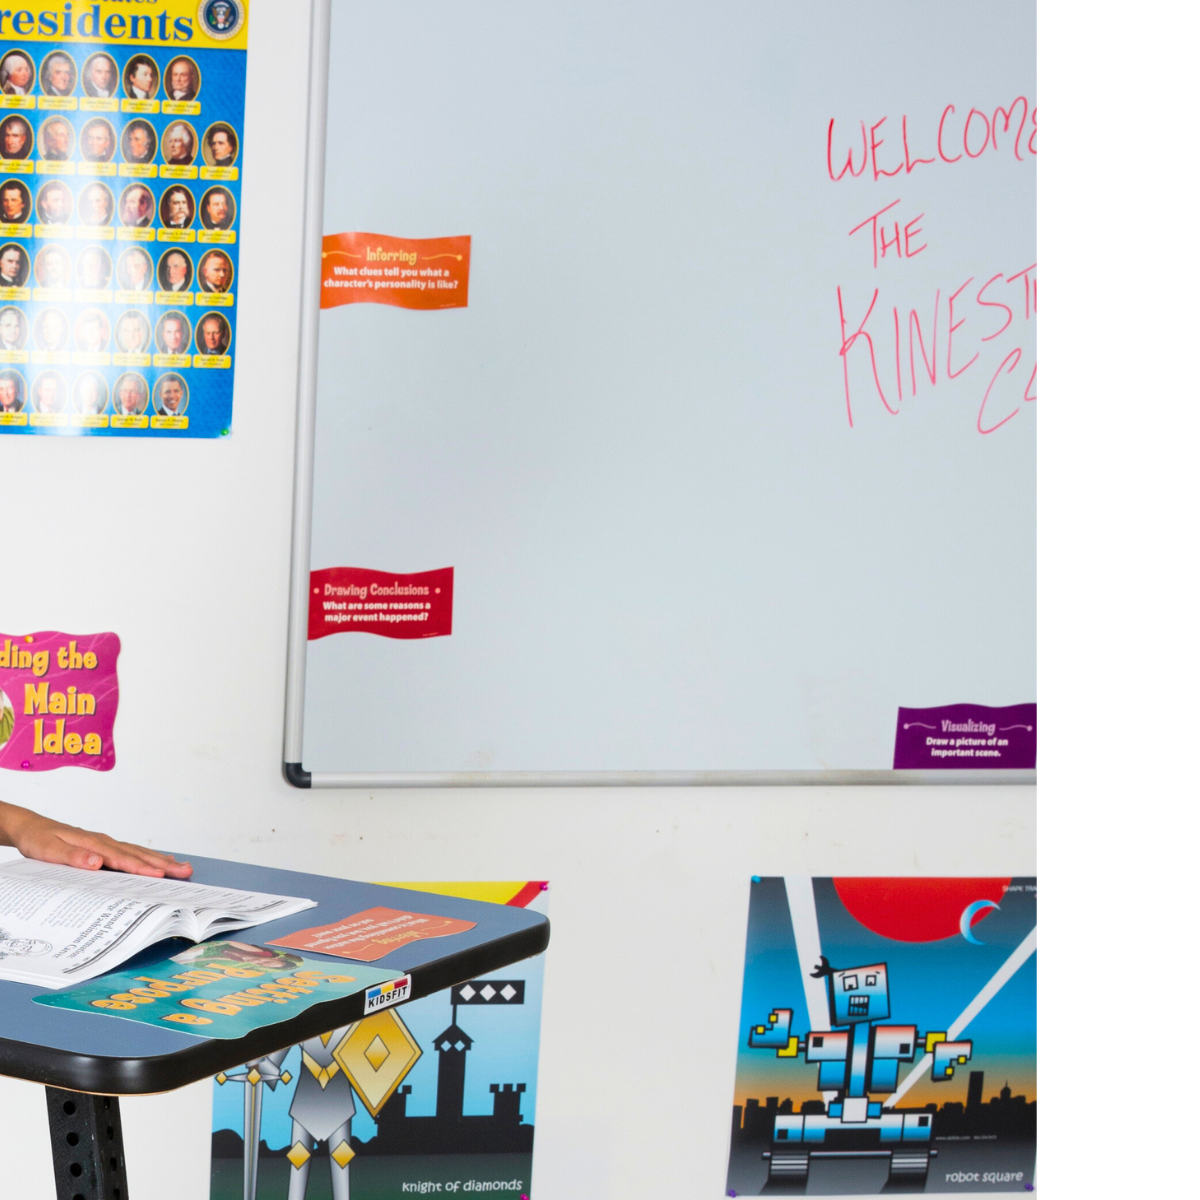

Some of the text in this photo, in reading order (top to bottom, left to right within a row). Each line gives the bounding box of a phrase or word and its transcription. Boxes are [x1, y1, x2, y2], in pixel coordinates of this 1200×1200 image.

[849, 199, 927, 268] THE
[367, 247, 417, 266] Inferring
[334, 267, 442, 278] What clues tell you what
[375, 280, 426, 290] personality
[437, 281, 458, 289] like?
[838, 263, 1037, 427] KINEST
[324, 582, 429, 600] Drawing Conclusions
[325, 613, 428, 623] major event happened?
[57, 641, 98, 669] the
[24, 682, 96, 715] Main
[941, 719, 996, 736] Visualizing
[33, 719, 102, 755] Idea
[926, 737, 947, 746] Draw
[956, 738, 985, 747] picture
[931, 748, 974, 758] important
[91, 963, 265, 1010] Purpose
[162, 971, 357, 1025] Setting a
[368, 986, 407, 1008] KIDSFIT
[445, 1181, 461, 1193] of
[463, 1179, 522, 1191] diamonds
[946, 1172, 1023, 1183] robot square
